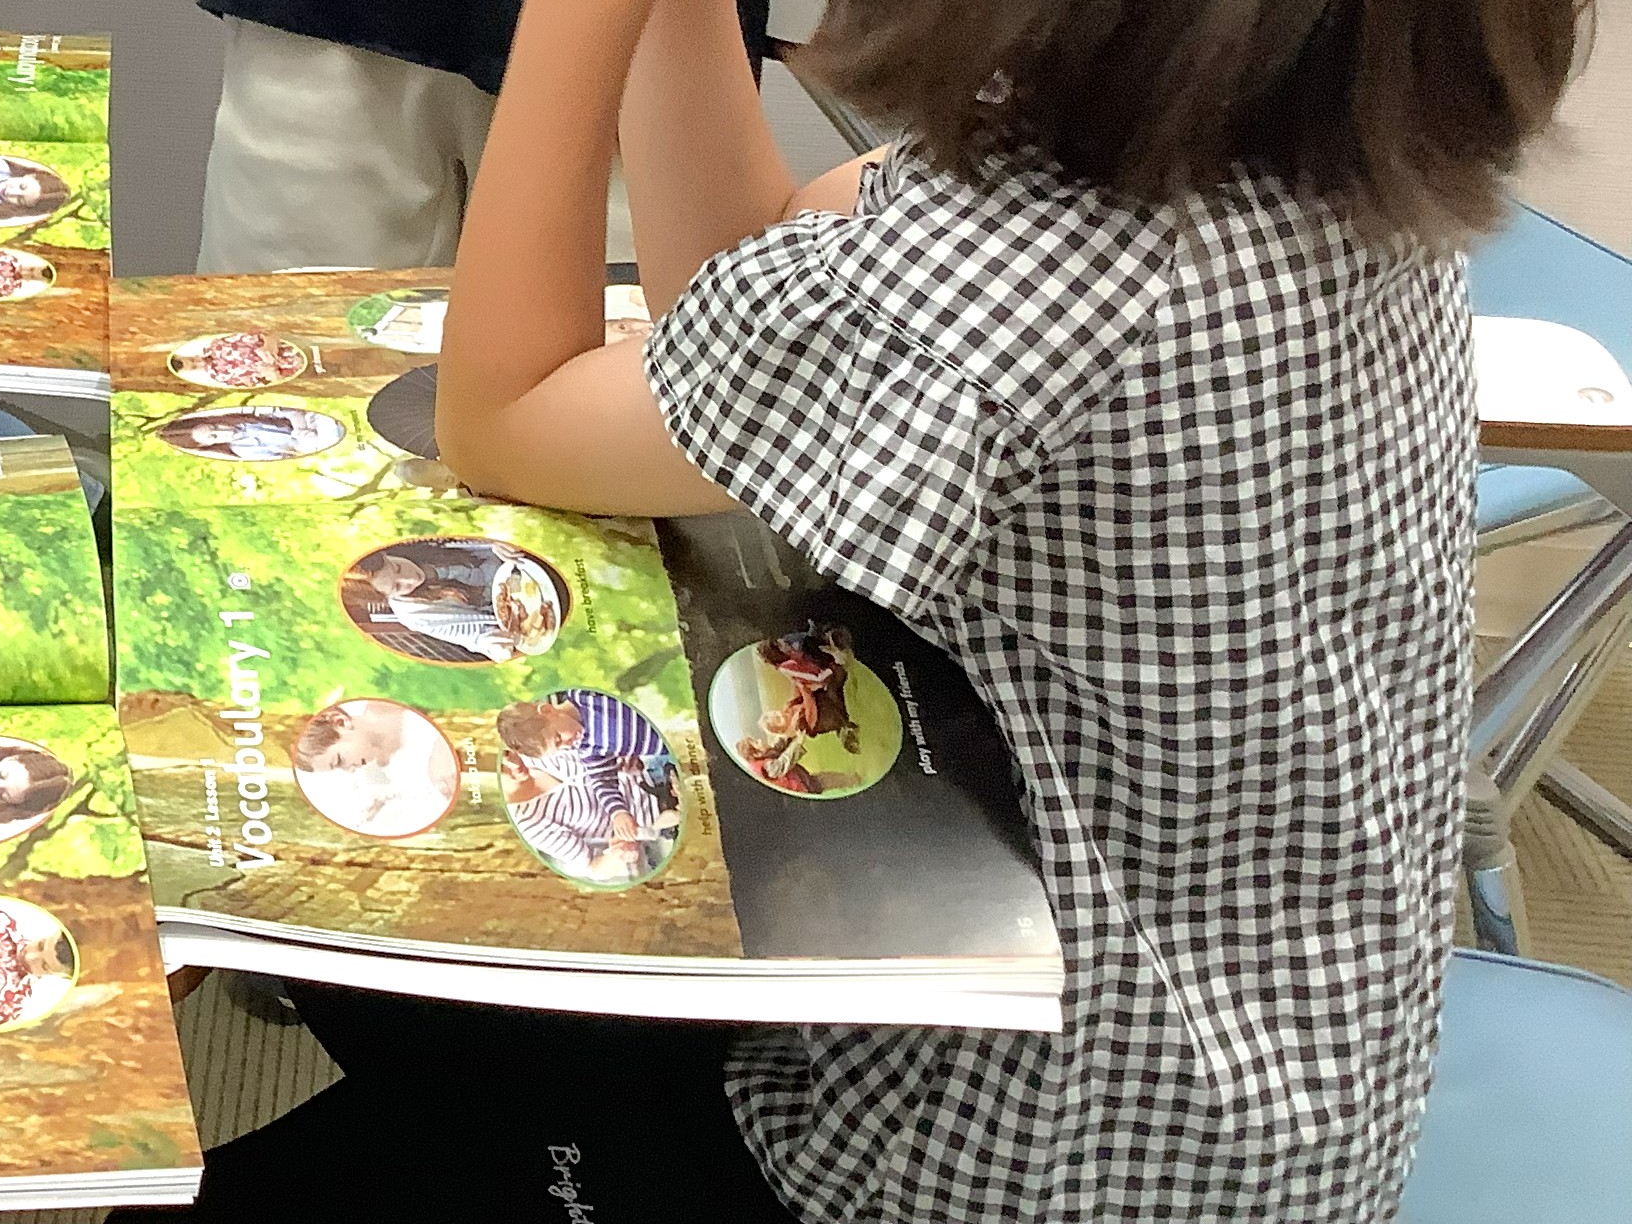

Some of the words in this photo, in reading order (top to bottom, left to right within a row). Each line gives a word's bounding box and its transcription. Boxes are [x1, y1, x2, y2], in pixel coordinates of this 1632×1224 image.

[574, 558, 592, 606] breakfast
[219, 611, 255, 627] 1
[584, 607, 597, 634] have
[892, 661, 913, 698] friends
[905, 699, 919, 718] my
[908, 719, 927, 746] with
[219, 639, 275, 869] Vocabulary
[464, 737, 477, 765] bath
[685, 738, 701, 776] dinner
[918, 747, 938, 775] play
[204, 769, 220, 821] Lesson
[468, 780, 483, 805] tak
[691, 779, 706, 805] with
[205, 825, 222, 837] 2
[698, 809, 713, 836] help
[208, 838, 225, 867] Unit
